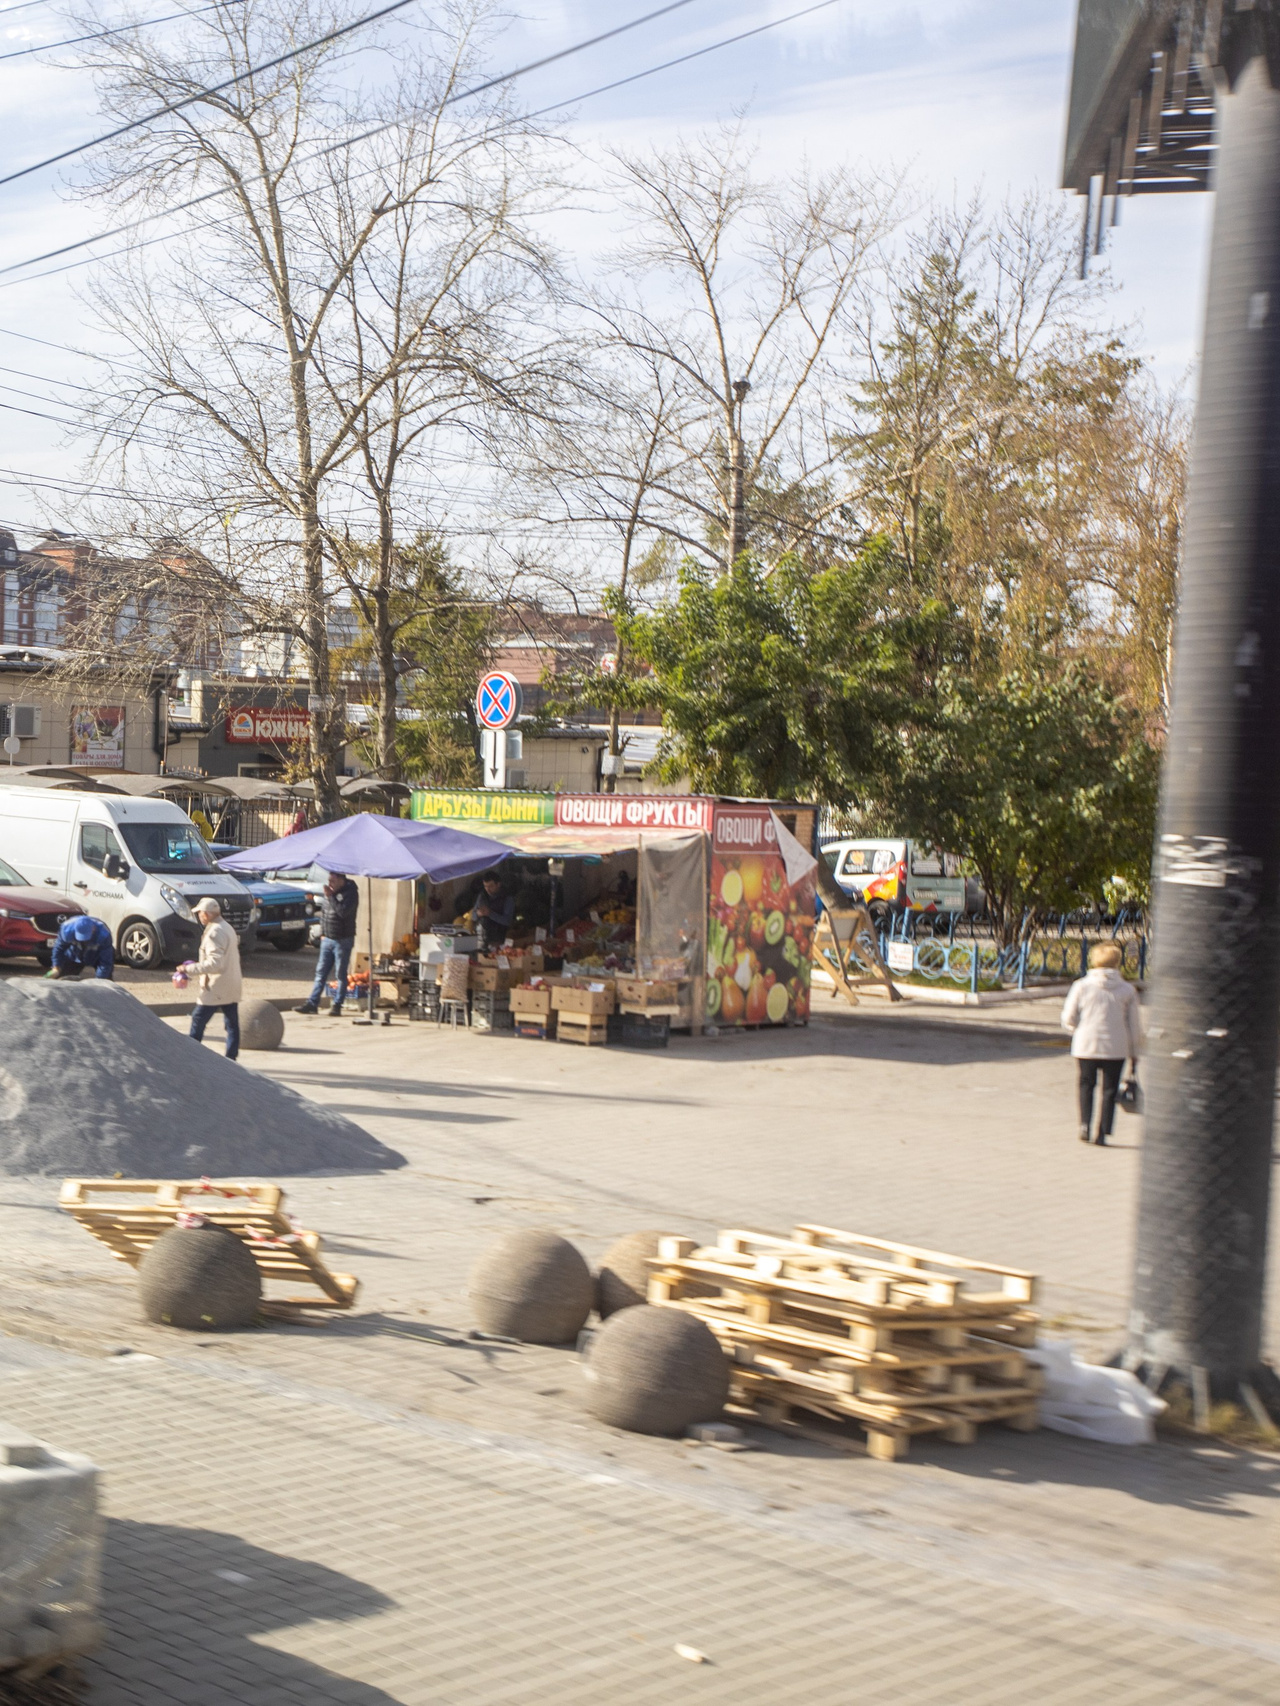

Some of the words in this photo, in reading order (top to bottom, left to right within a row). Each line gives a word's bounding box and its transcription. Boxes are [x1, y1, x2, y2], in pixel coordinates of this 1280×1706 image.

[422, 793, 487, 818] АРБУЗЫ
[489, 797, 539, 822] ДЫНИ
[561, 798, 623, 826] ОВОЩИ
[625, 799, 704, 827] ФРУКТЫ
[717, 817, 762, 847] ОВОЩИ
[91, 890, 125, 900] YOKOHAMA
